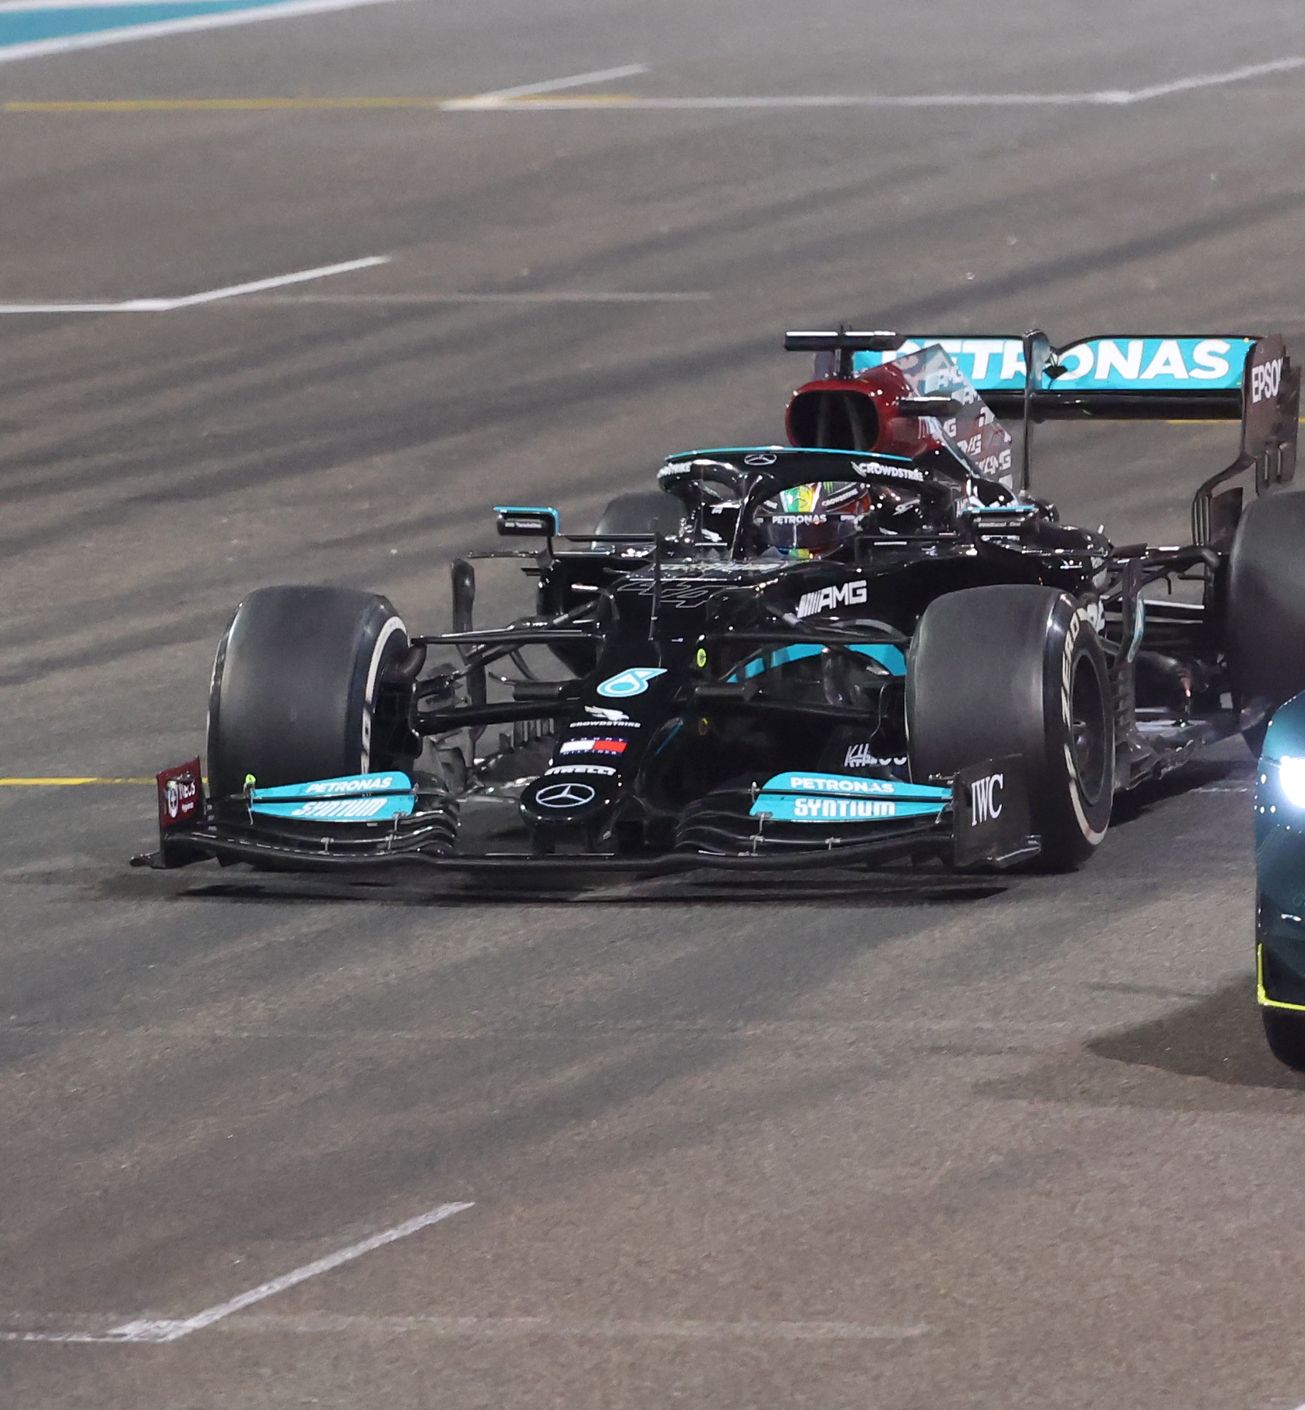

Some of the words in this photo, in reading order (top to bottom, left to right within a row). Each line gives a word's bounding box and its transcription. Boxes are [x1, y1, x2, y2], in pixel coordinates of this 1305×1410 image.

[772, 514, 828, 526] PETRONAS
[305, 777, 393, 793] PETRONAS
[790, 777, 895, 793] PETRONAS
[291, 798, 389, 816] SYNTIUM
[793, 798, 896, 817] SYNTIUM
[971, 773, 1004, 827] IWC
